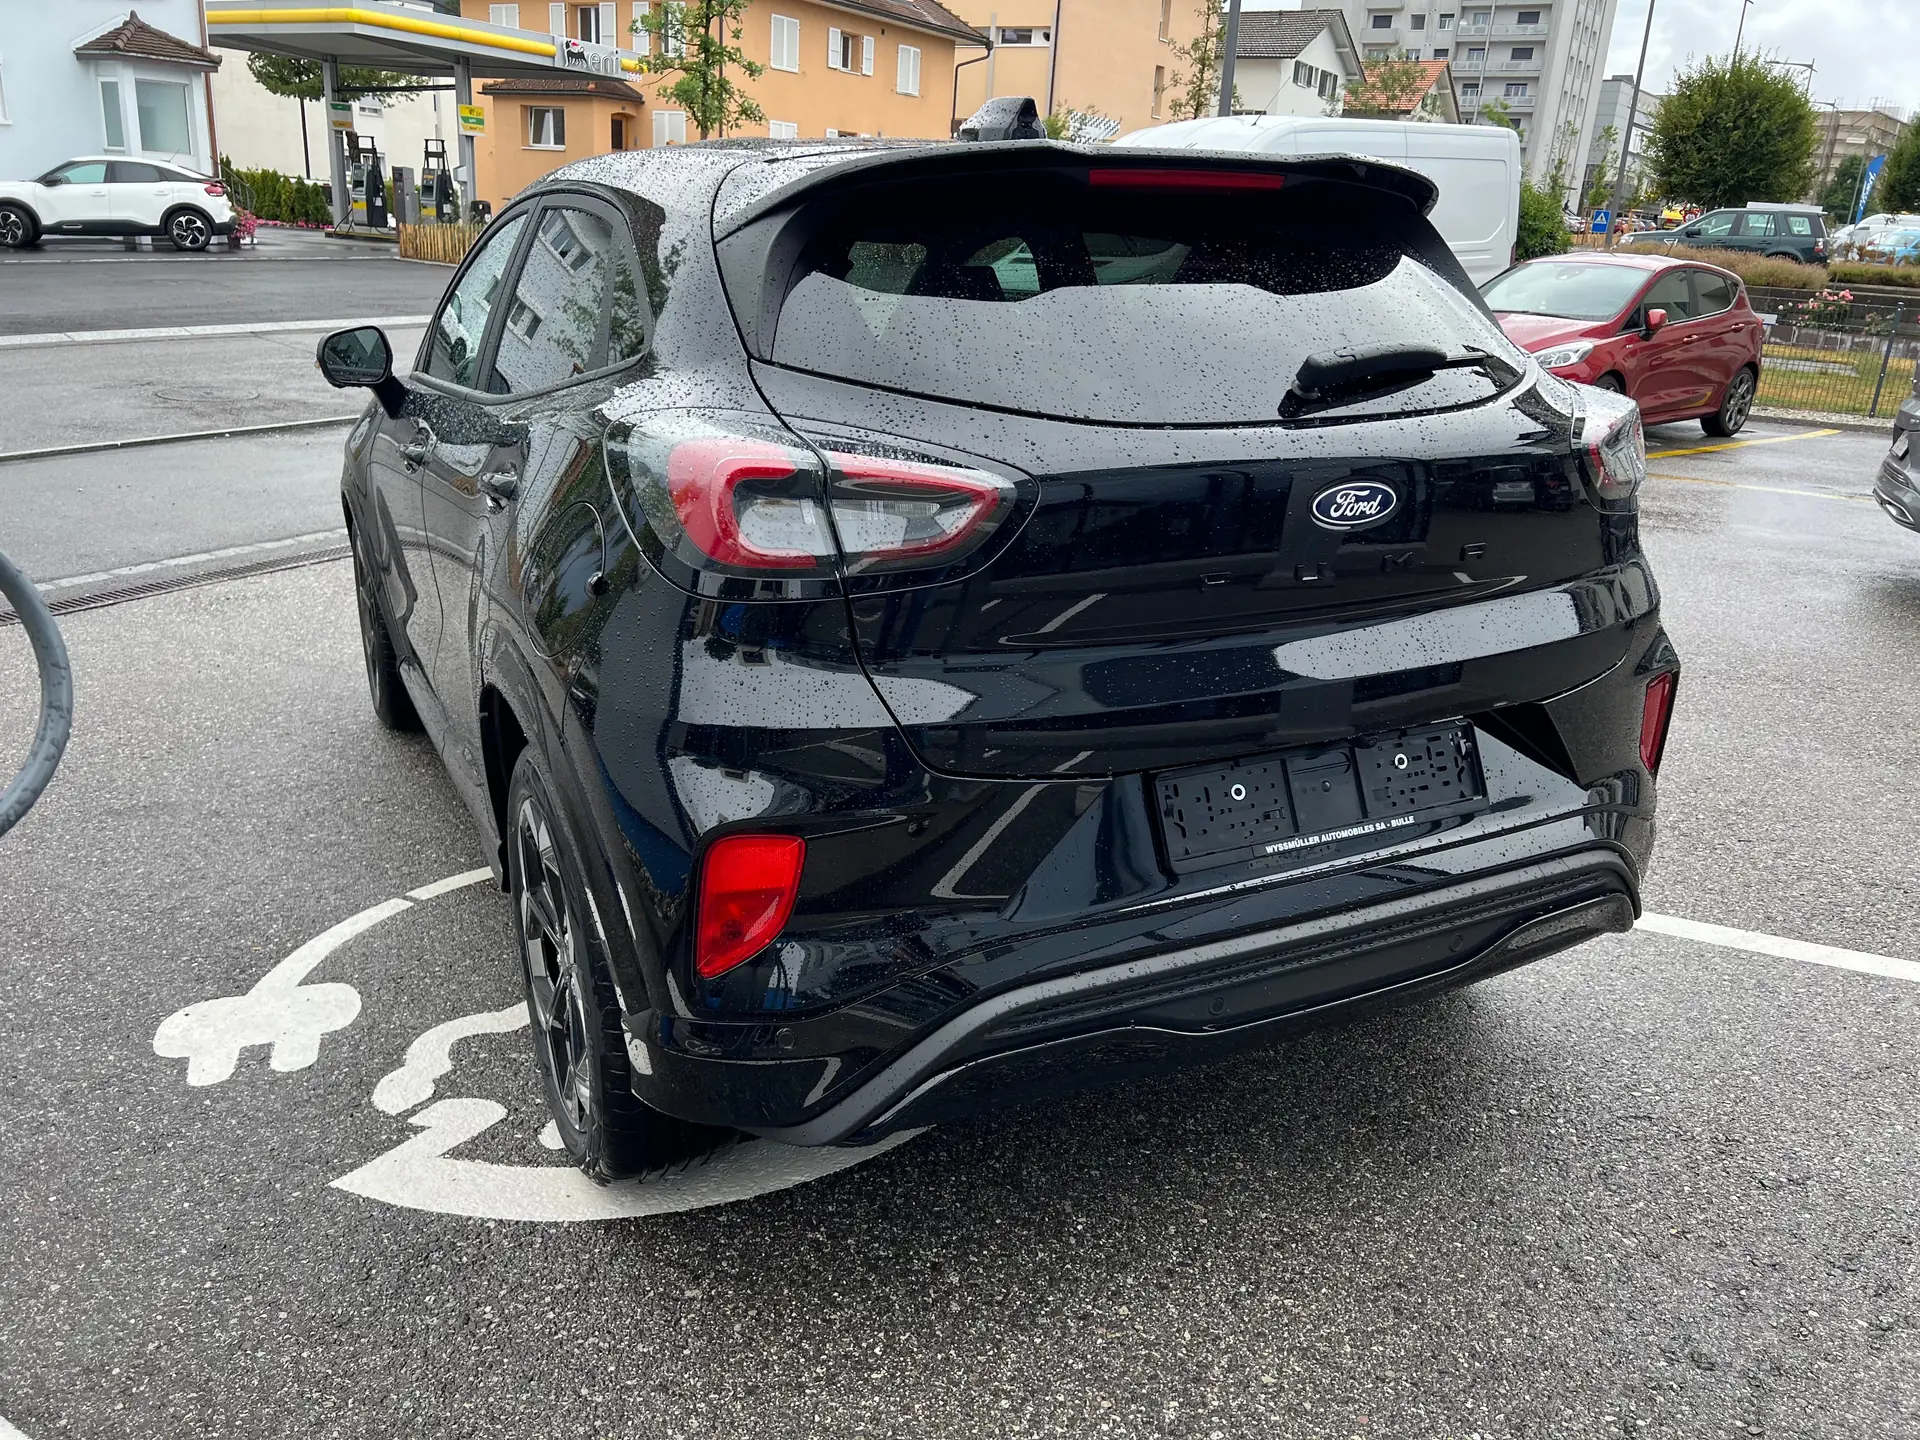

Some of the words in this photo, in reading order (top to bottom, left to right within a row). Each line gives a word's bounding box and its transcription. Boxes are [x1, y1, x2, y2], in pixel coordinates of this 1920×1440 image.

[588, 50, 619, 75] eni
[1330, 489, 1382, 518] Ford
[1265, 838, 1320, 854] WYSSMÜLLER
[1321, 823, 1375, 843] AUTOMOBILES
[1375, 821, 1387, 831] SA
[1391, 815, 1415, 828] BULLE
